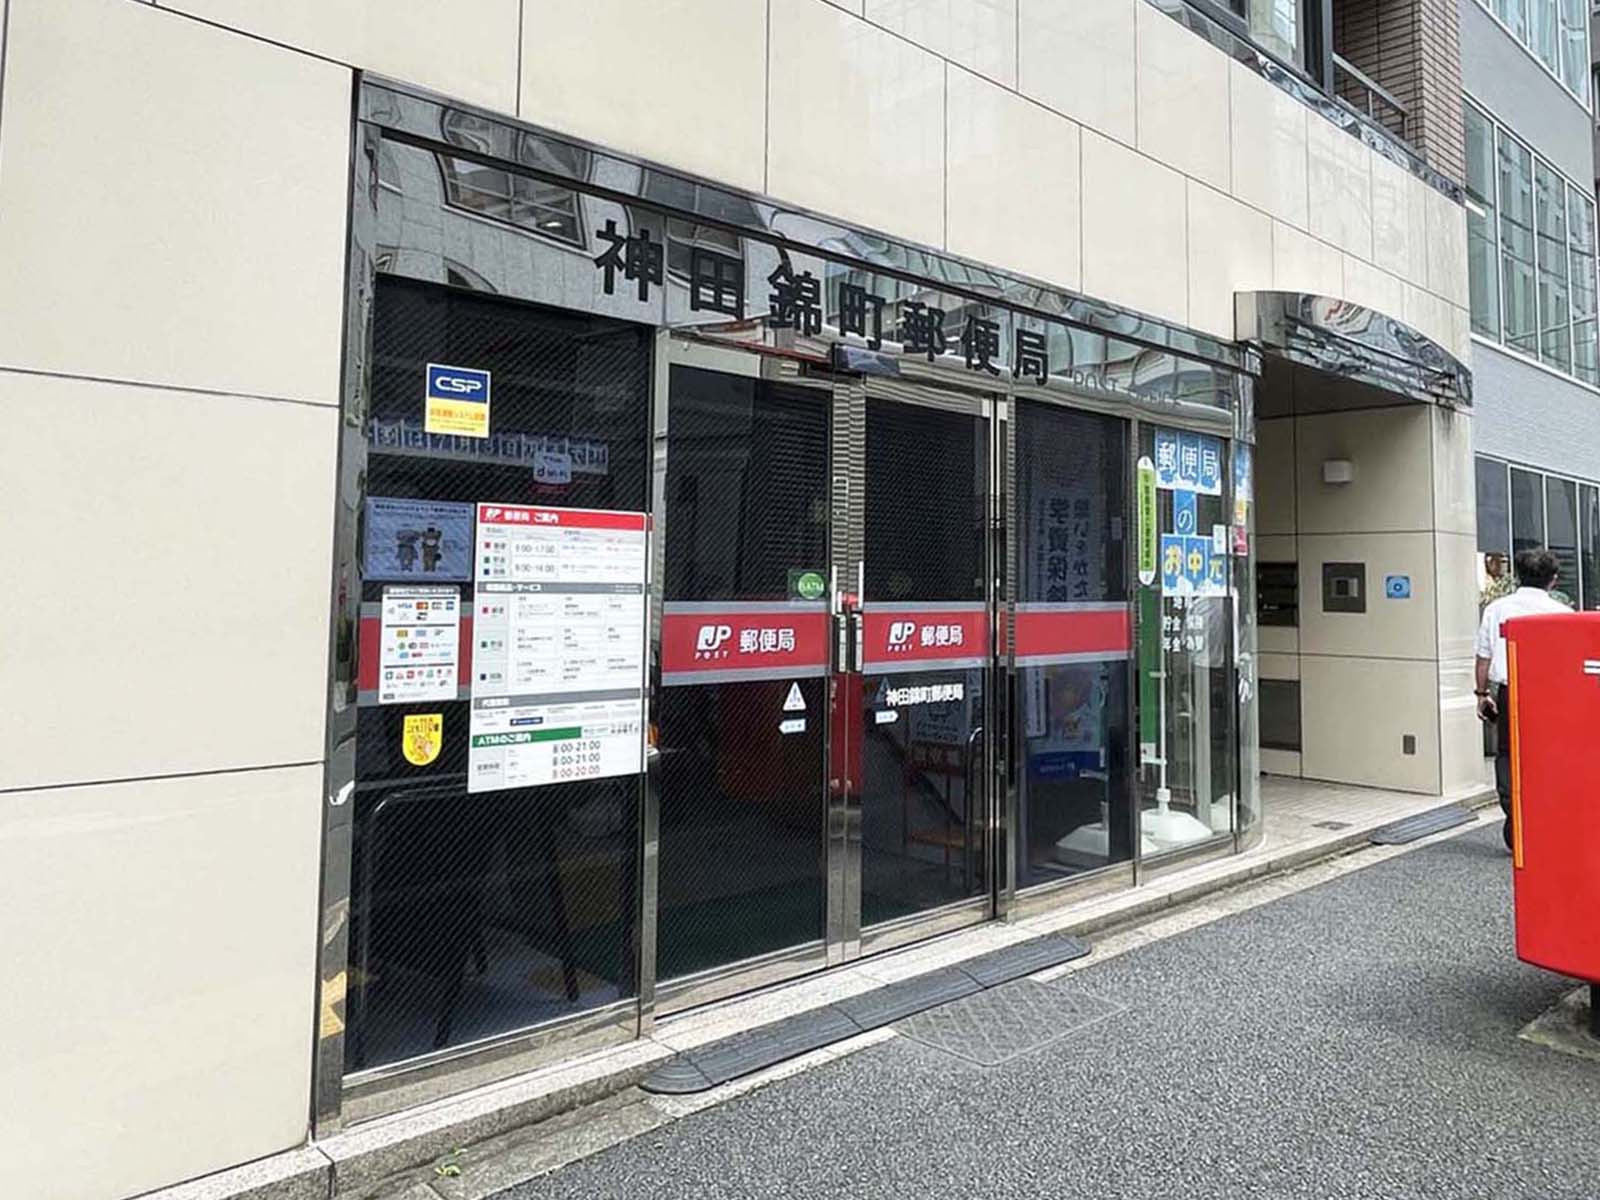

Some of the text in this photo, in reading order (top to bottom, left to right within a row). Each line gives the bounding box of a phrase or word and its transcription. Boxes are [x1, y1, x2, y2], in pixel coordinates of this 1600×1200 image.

[593, 219, 1050, 387] 神田錦町郵便局
[435, 376, 483, 393] CSP
[1157, 442, 1220, 480] 郵便局
[1178, 510, 1193, 530] の
[1164, 543, 1224, 579] お中元
[696, 625, 796, 655] JP 郵便局
[888, 621, 963, 647] JP 郵便局
[694, 650, 730, 660] POST
[886, 683, 964, 707] 神田錦町郵便局
